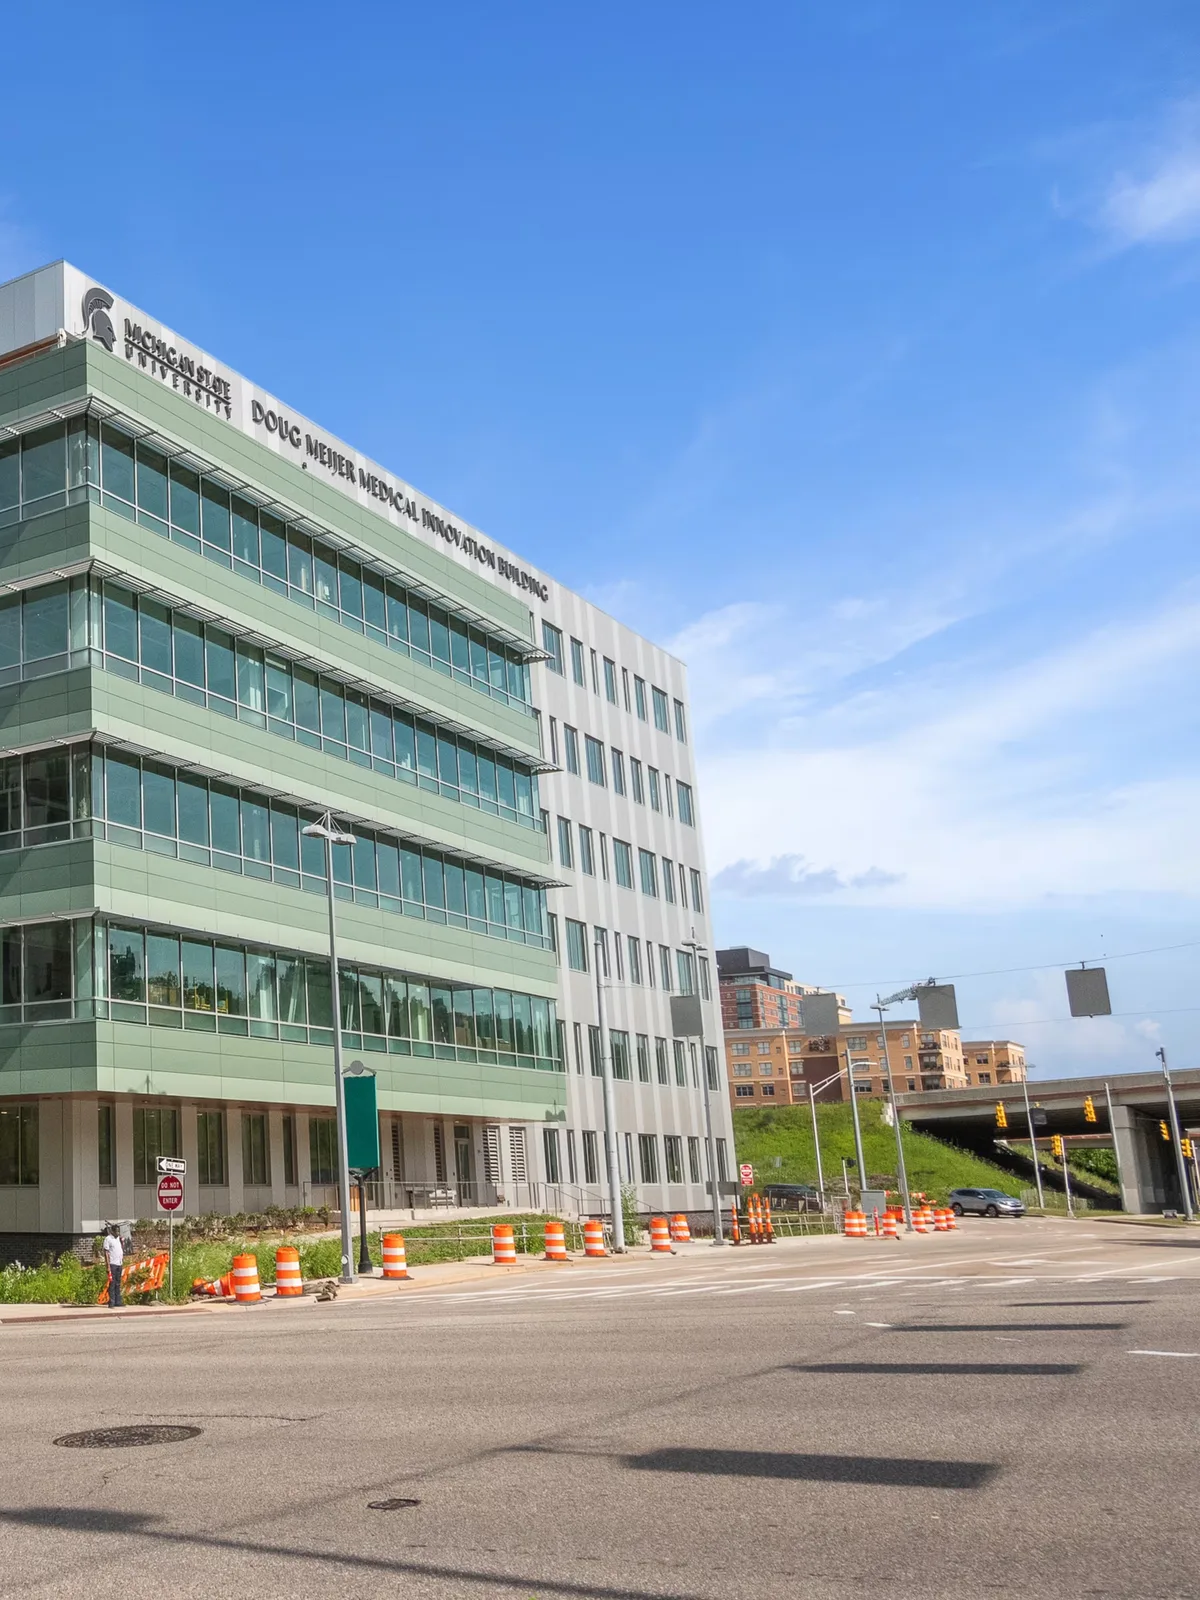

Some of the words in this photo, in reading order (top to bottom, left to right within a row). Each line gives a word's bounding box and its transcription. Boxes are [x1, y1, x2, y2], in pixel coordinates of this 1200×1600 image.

[124, 318, 195, 378] MICHIGAN
[196, 365, 232, 401] STATE
[124, 343, 232, 421] UNIVERSITY
[251, 399, 302, 449] DOUG
[305, 433, 357, 484] MEIJER
[358, 467, 420, 523] MEDICAL
[421, 507, 496, 570] INNOVATION
[497, 556, 549, 603] BUILDING
